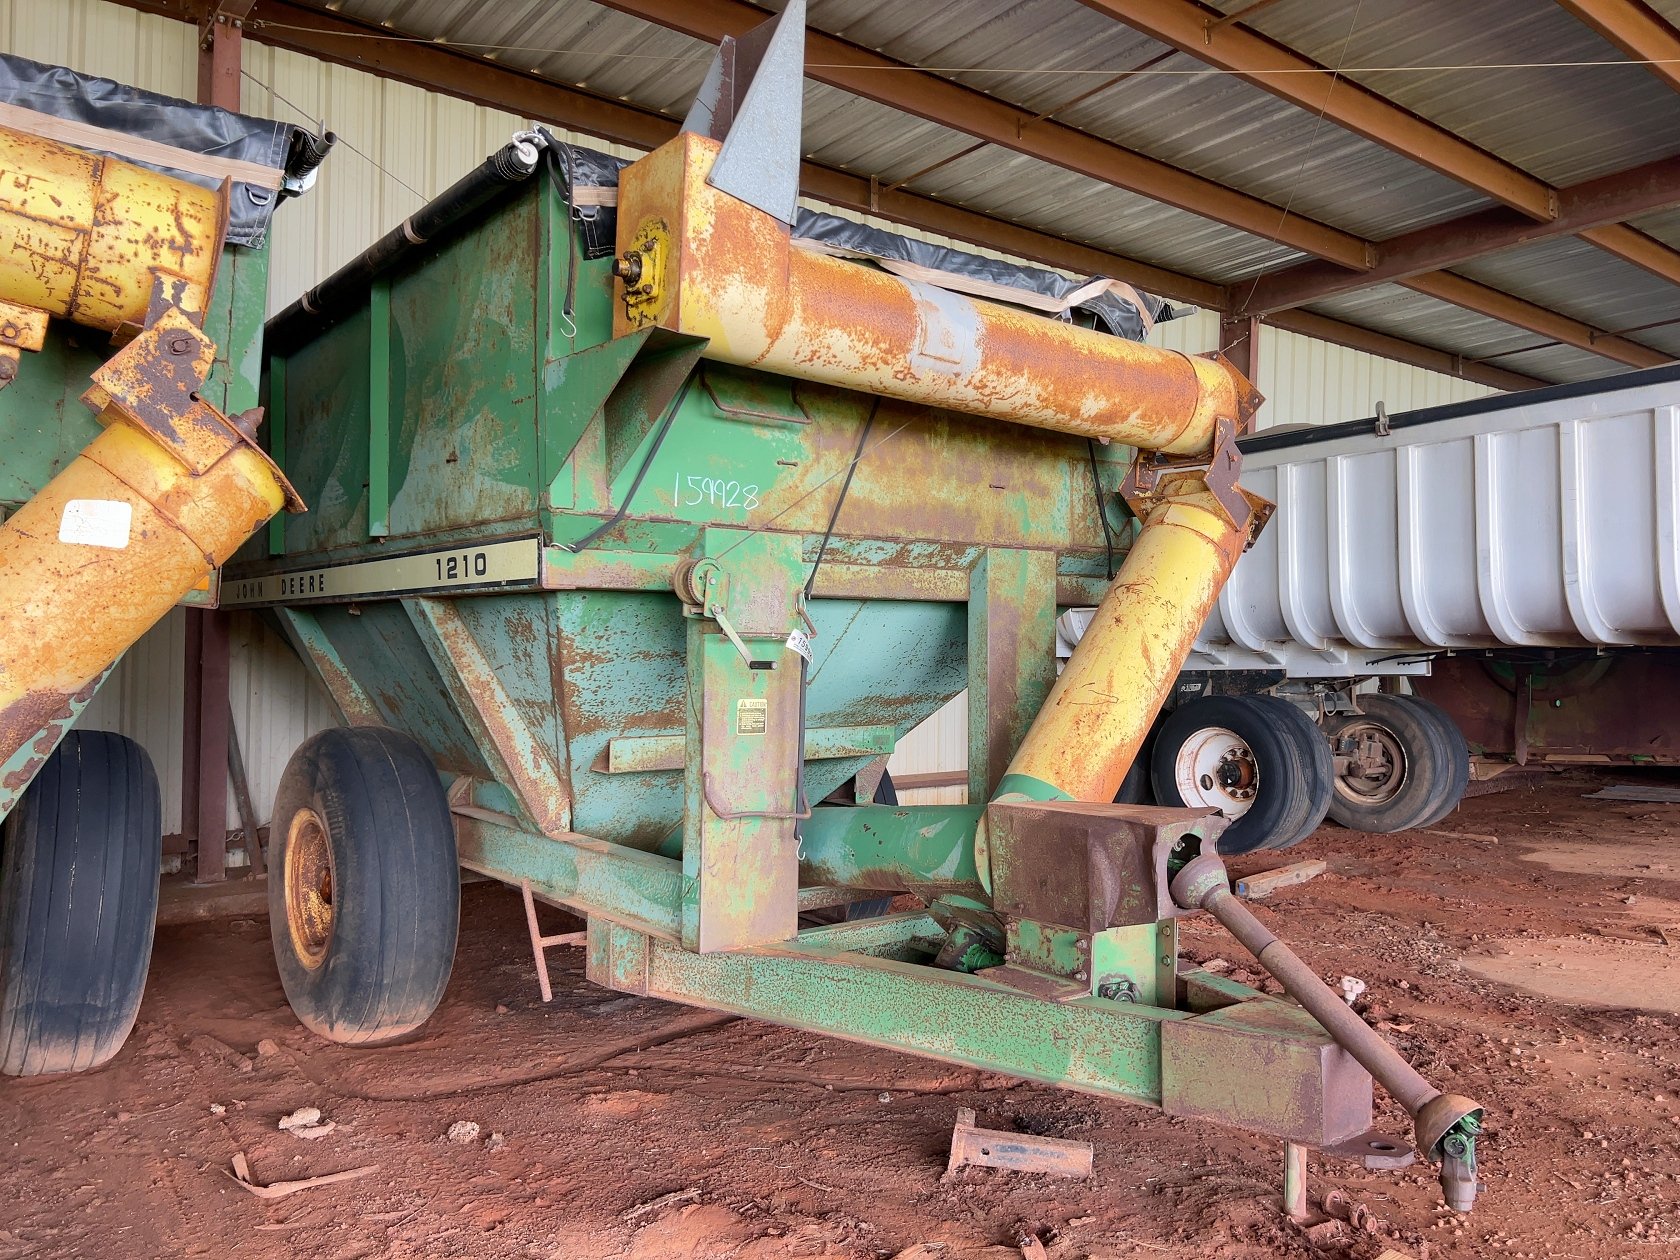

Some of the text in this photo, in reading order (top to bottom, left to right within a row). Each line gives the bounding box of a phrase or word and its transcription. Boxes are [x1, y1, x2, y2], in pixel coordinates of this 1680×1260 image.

[674, 471, 759, 510] 159928
[436, 552, 487, 581] 1210
[236, 573, 324, 599] JOHN DEERE
